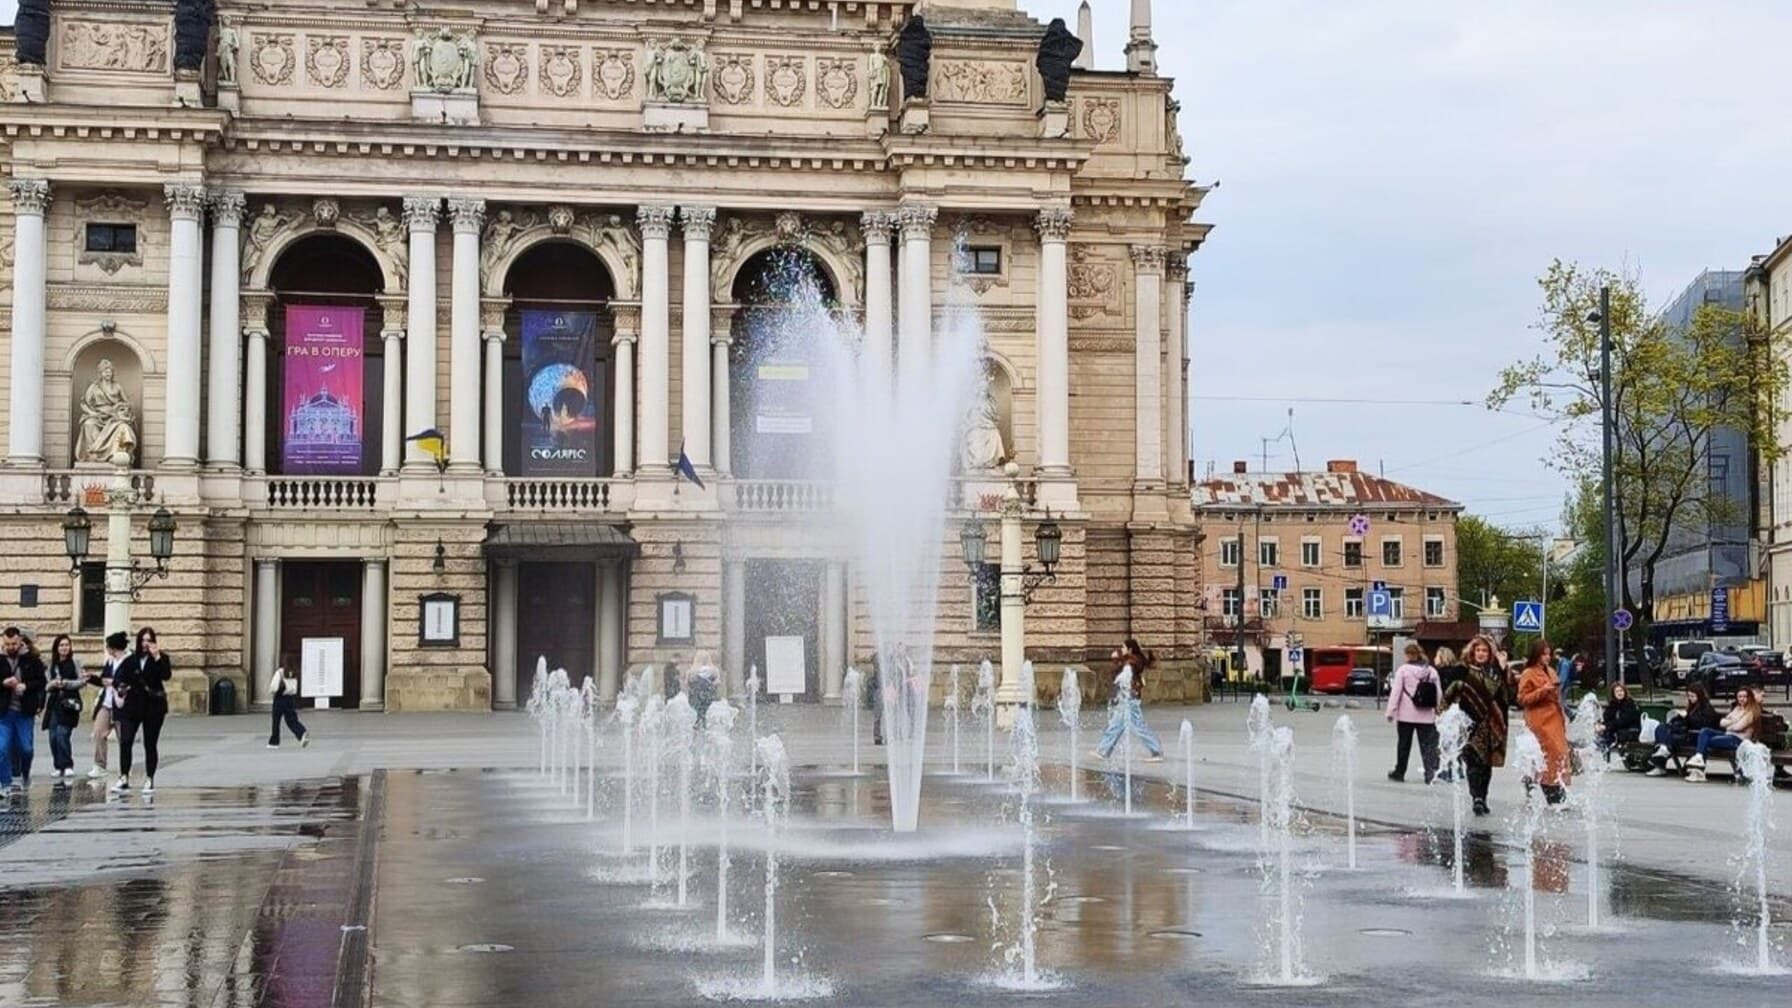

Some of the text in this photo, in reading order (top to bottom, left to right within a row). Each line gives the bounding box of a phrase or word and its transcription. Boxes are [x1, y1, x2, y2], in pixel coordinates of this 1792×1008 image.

[287, 346, 360, 358] ГРА В ОПЕРУ
